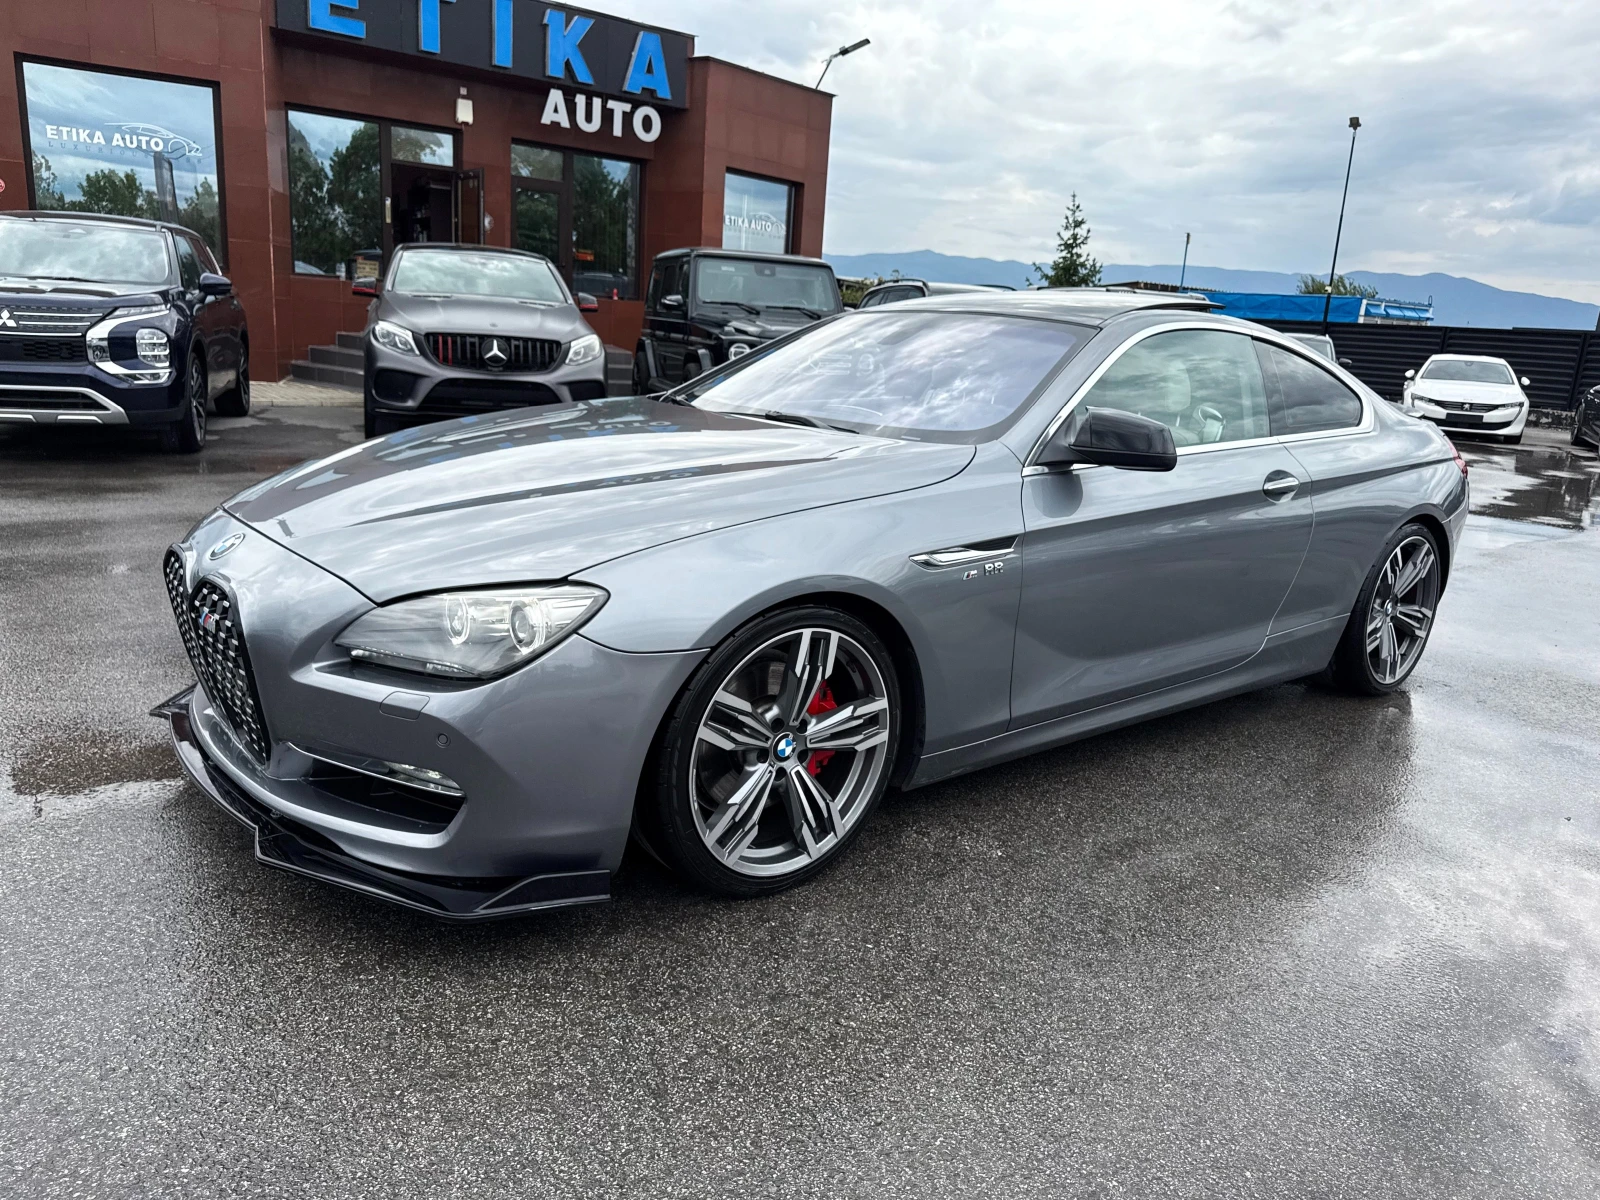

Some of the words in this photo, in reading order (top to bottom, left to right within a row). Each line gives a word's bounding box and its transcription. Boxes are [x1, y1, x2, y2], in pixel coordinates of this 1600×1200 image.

[540, 88, 662, 143] AUTO
[45, 125, 106, 145] ETIKA
[111, 132, 164, 152] AUTO
[725, 215, 749, 228] ETIKA
[750, 218, 772, 232] AUTO
